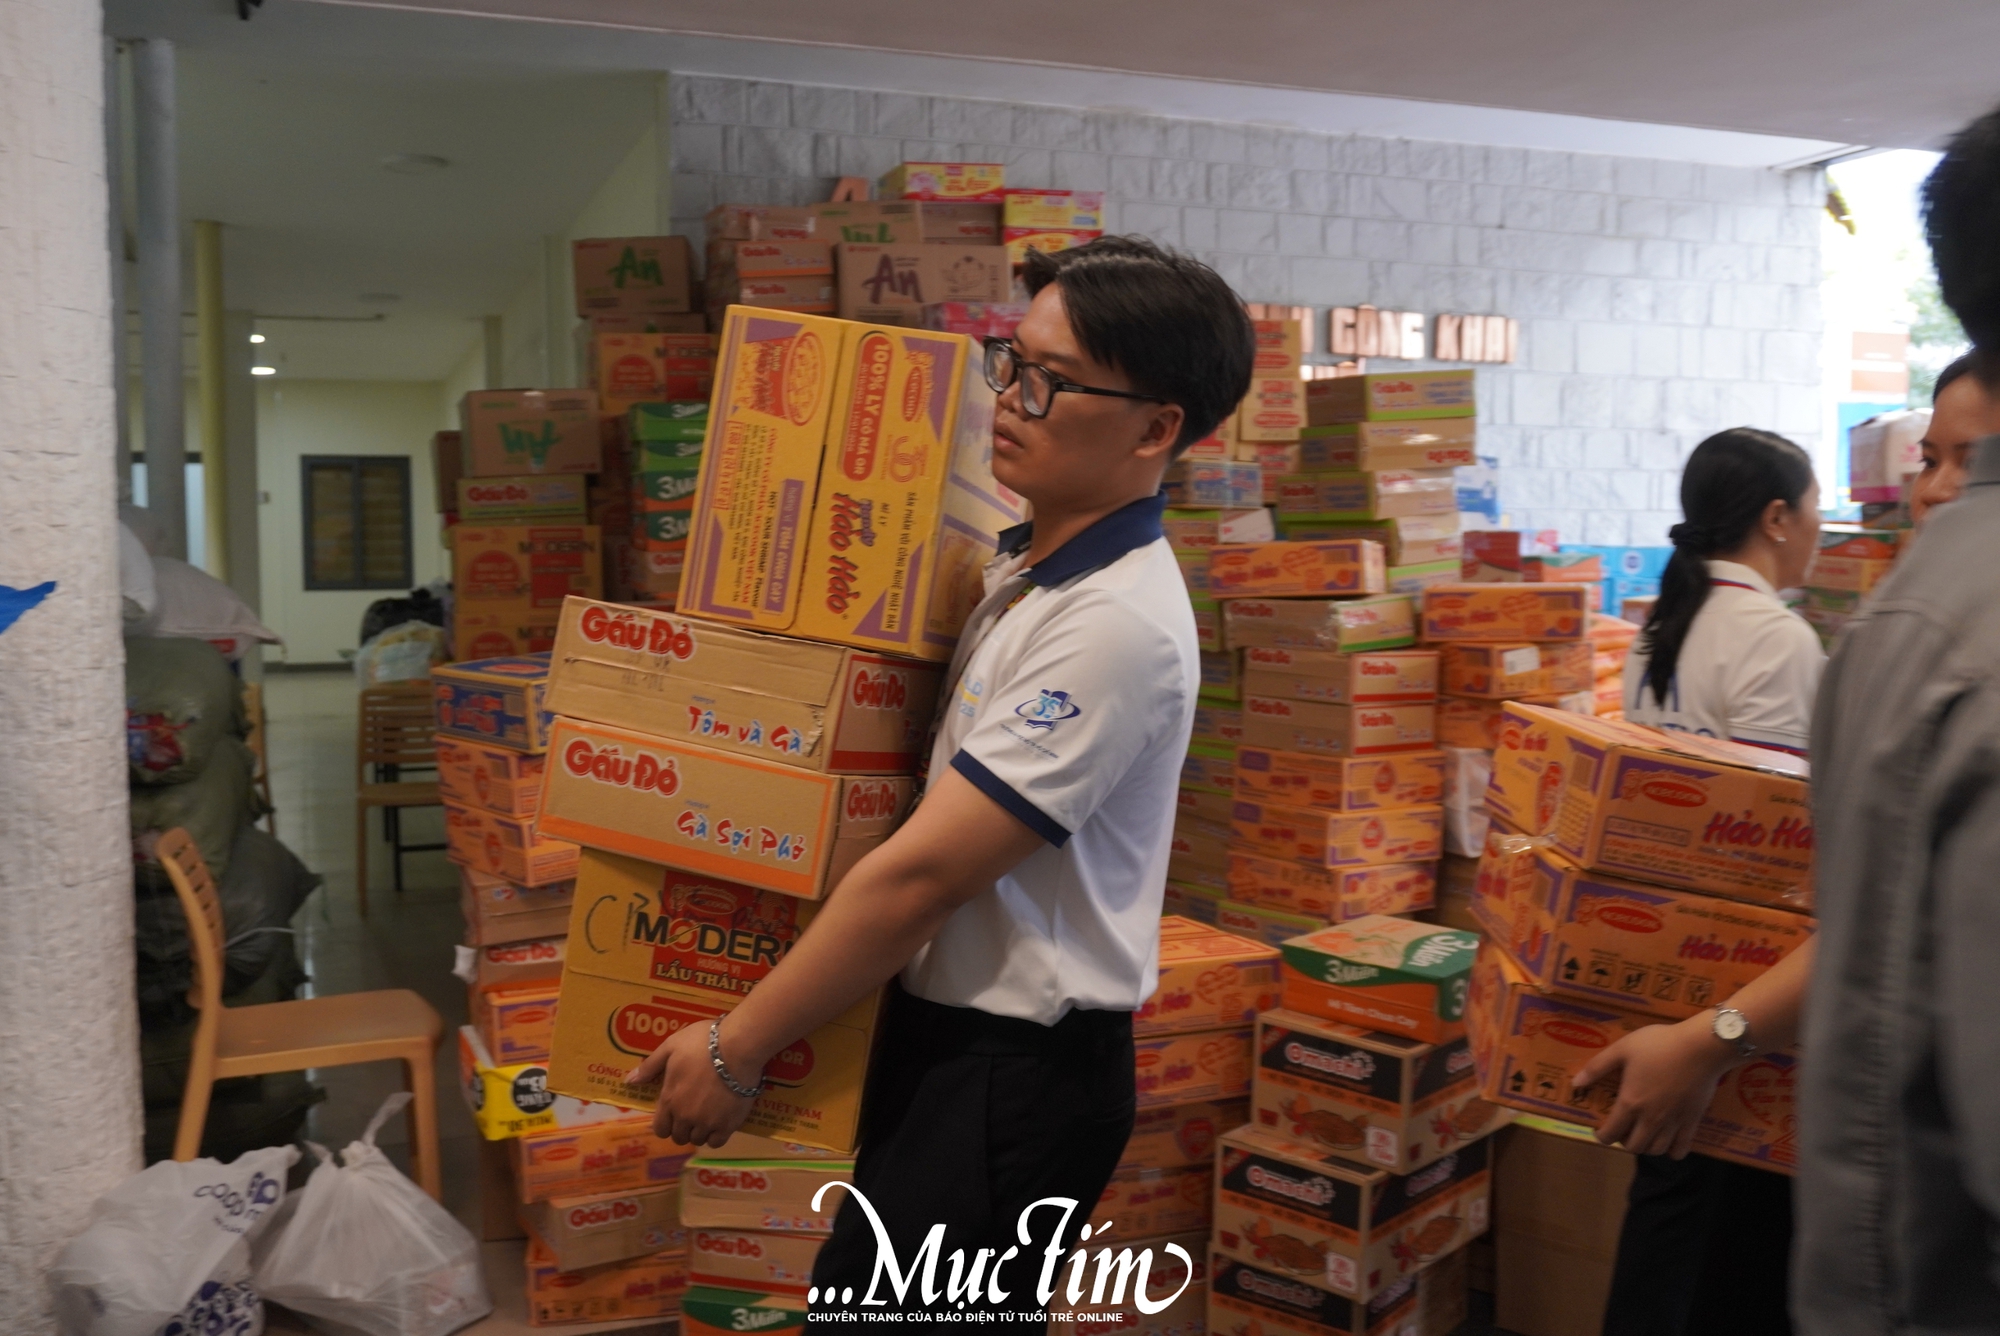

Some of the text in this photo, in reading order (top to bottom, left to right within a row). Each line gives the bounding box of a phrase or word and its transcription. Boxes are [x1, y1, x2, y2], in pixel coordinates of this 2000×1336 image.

[867, 341, 891, 392] 100%
[862, 393, 881, 416] LY
[860, 416, 873, 435] CÓ
[852, 457, 866, 475] QR
[826, 492, 863, 614] Hảo Hảo
[582, 606, 694, 659] Gấu Đỏ
[689, 706, 802, 753] Tôm và Gà
[566, 740, 678, 796] Gấu Đỏ
[677, 811, 806, 860] Gà Sợi Phở
[1704, 809, 1767, 847] Hảo
[632, 912, 794, 967] MODER
[1678, 933, 1779, 966] Hảo Hảo
[656, 959, 692, 981] LẨU
[694, 971, 737, 992] THÁI
[587, 1062, 622, 1078] CÔNG
[763, 1099, 822, 1120] VIỆT NAM
